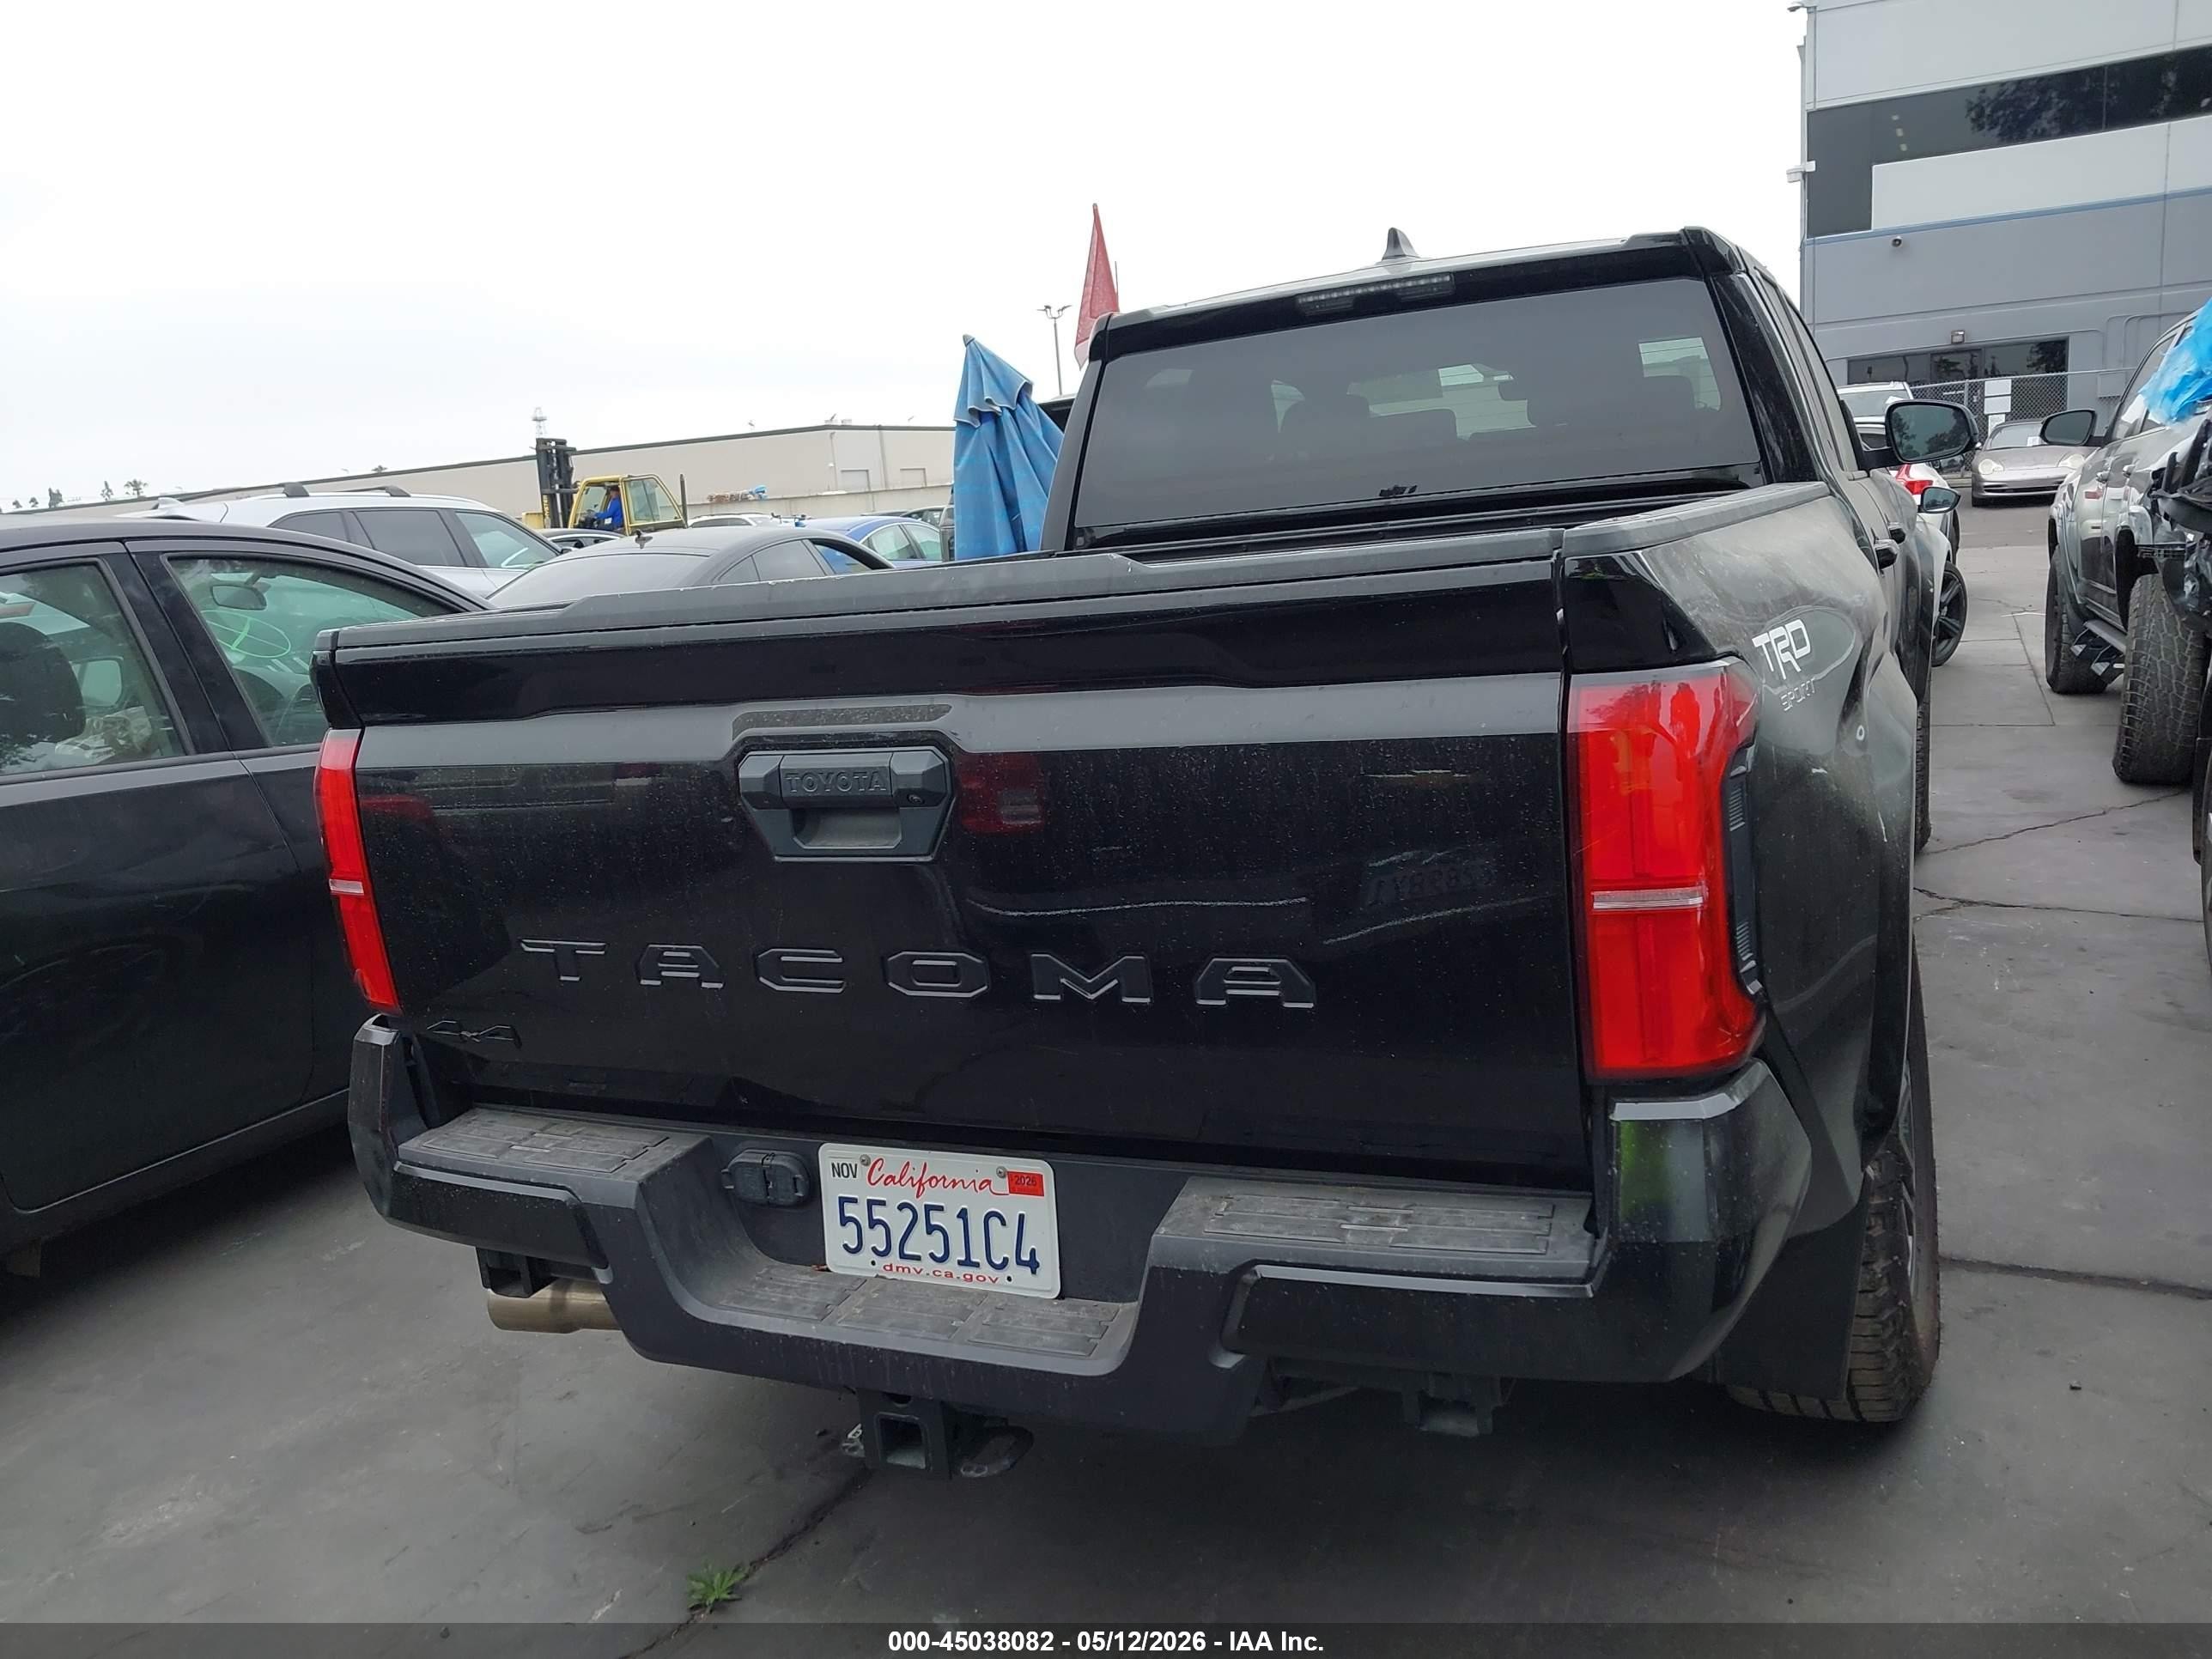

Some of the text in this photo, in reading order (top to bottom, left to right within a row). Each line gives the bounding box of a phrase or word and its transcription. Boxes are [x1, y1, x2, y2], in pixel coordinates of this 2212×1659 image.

[1752, 619, 1811, 679] TRD
[1780, 678, 1815, 712] SPORT
[785, 771, 887, 793] TOYOTA
[520, 938, 1317, 1010] TACOMA
[831, 1162, 858, 1179] NOV
[867, 1158, 1009, 1200] California
[837, 1195, 1041, 1275] 55251C4
[883, 1263, 1000, 1285] dmv.ca.gov
